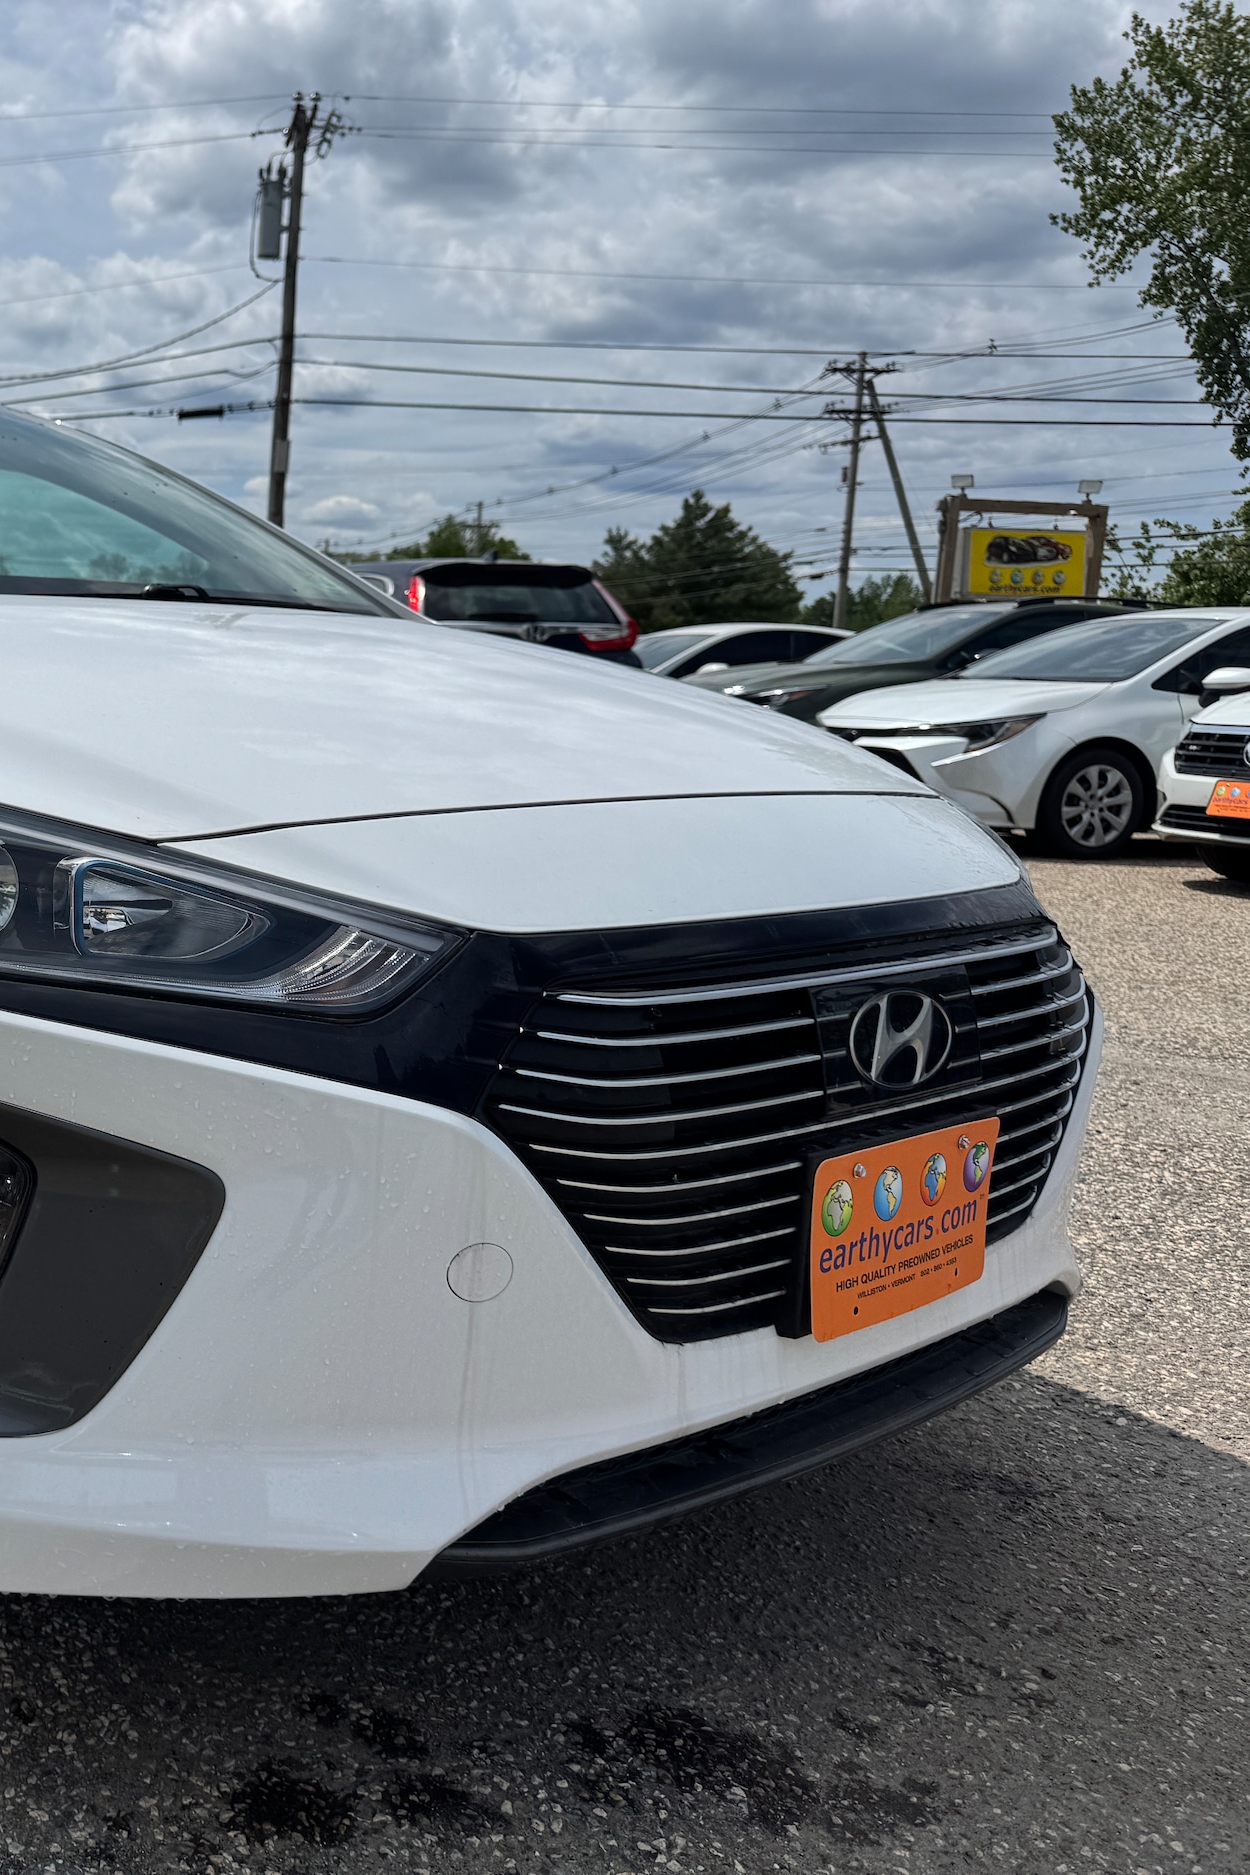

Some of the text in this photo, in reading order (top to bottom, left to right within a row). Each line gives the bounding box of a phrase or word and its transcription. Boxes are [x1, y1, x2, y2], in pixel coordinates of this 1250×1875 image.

[819, 1199, 977, 1274] earthycars.com
[836, 1234, 974, 1293] HIGH QUALITY PREOWNED VEHICLES
[890, 1274, 916, 1288] VERMONT
